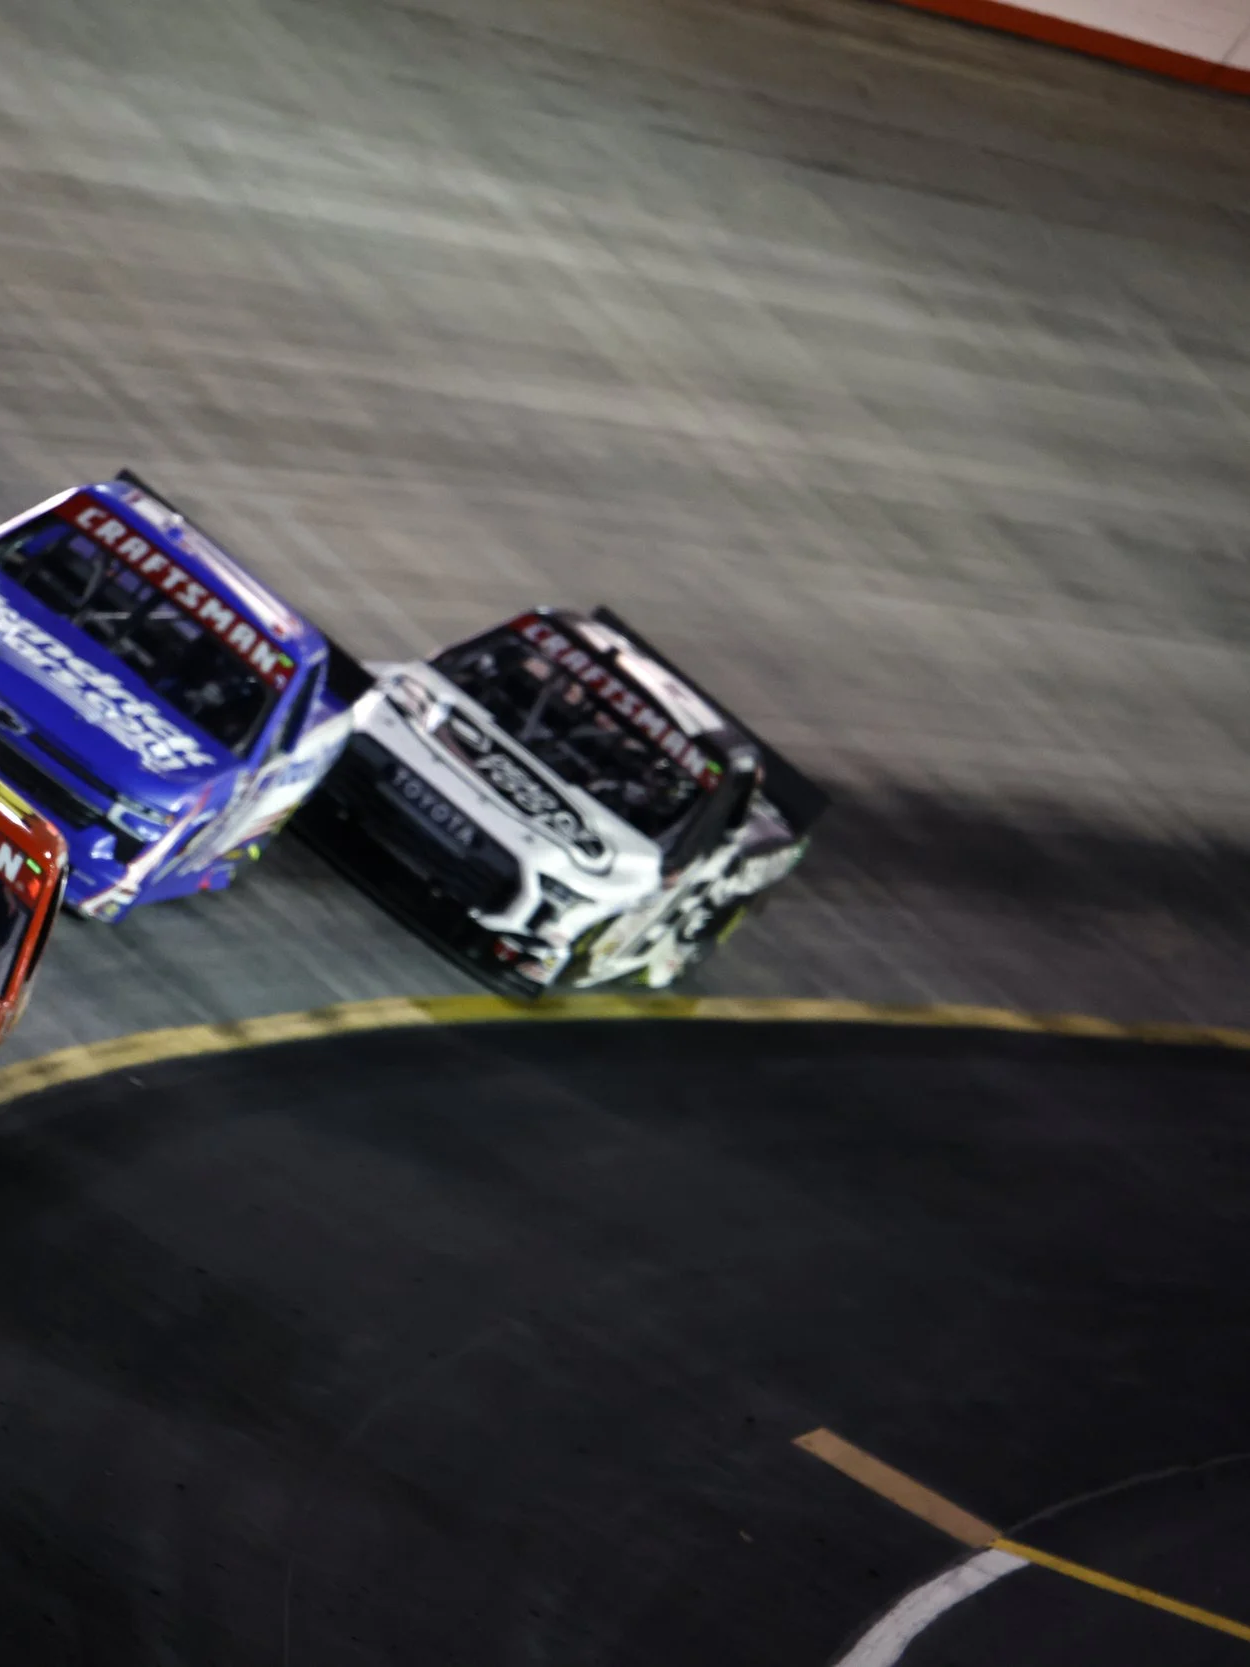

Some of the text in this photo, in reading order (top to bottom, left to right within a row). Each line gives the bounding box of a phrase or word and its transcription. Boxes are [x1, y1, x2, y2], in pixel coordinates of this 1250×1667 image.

[75, 506, 280, 678] CRAFTSMAN
[523, 622, 715, 784] CRAFTSMAN
[393, 767, 476, 846] TOYOTA
